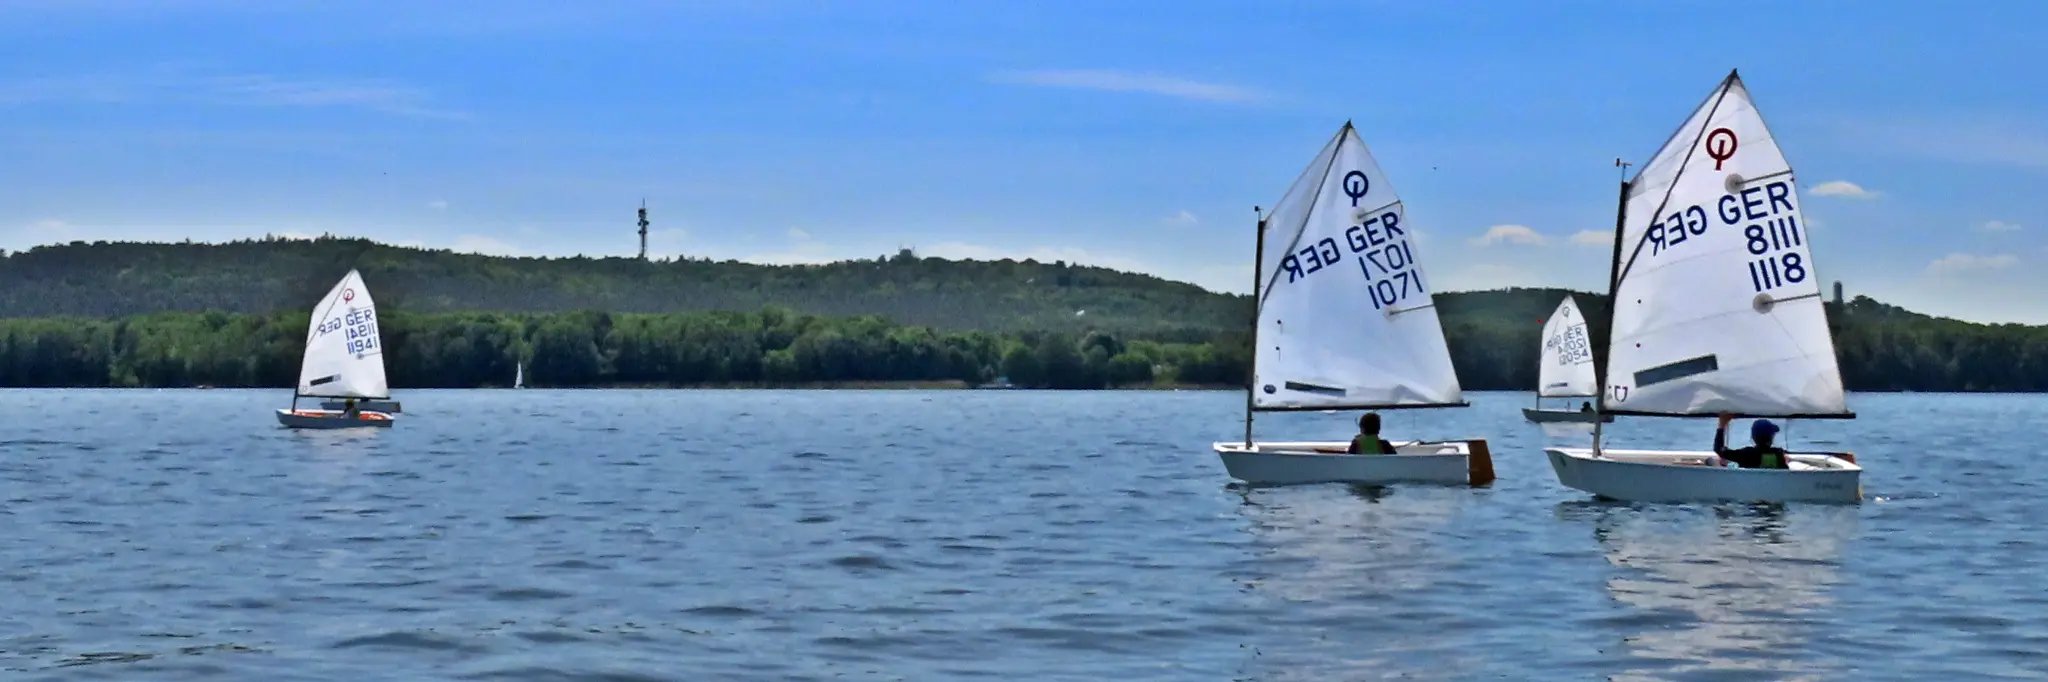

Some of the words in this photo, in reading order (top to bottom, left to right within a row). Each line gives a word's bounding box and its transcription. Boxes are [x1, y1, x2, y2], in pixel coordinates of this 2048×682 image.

[1718, 181, 1794, 225] GER
[1345, 211, 1404, 253] GER
[1367, 269, 1423, 310] 1071
[1748, 252, 1806, 292] 1118
[345, 309, 374, 326] GER
